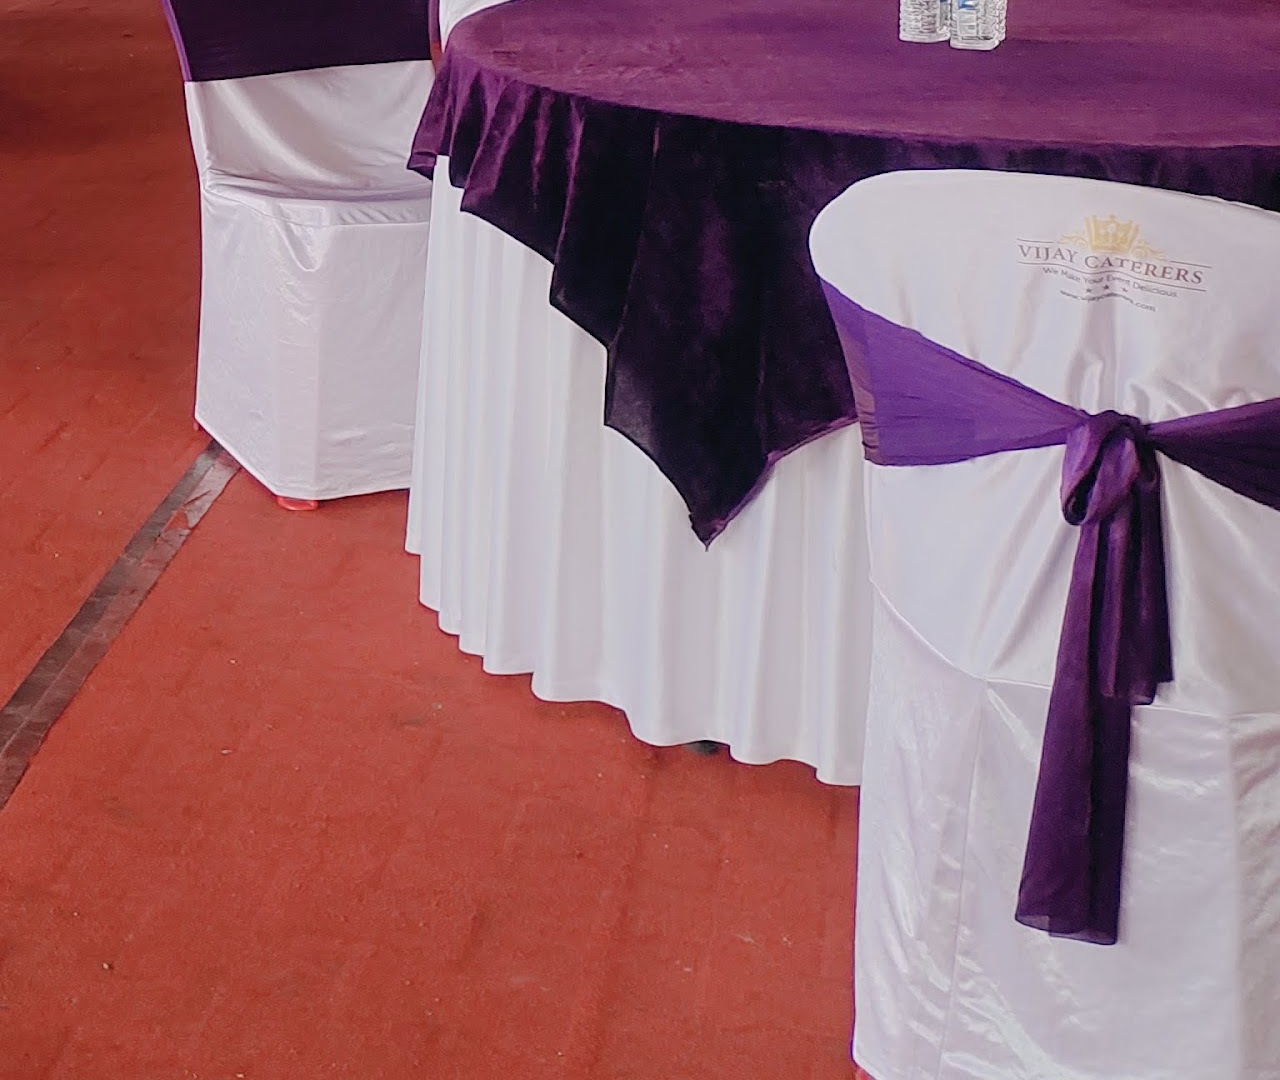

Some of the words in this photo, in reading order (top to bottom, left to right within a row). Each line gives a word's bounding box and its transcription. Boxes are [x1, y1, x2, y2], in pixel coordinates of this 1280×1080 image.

[1018, 244, 1078, 263] VIJAY
[1084, 255, 1204, 284] CATERERS
[1043, 266, 1059, 275] We
[1060, 269, 1081, 283] Make
[1084, 275, 1104, 285] Your
[1132, 281, 1178, 298] Delicious
